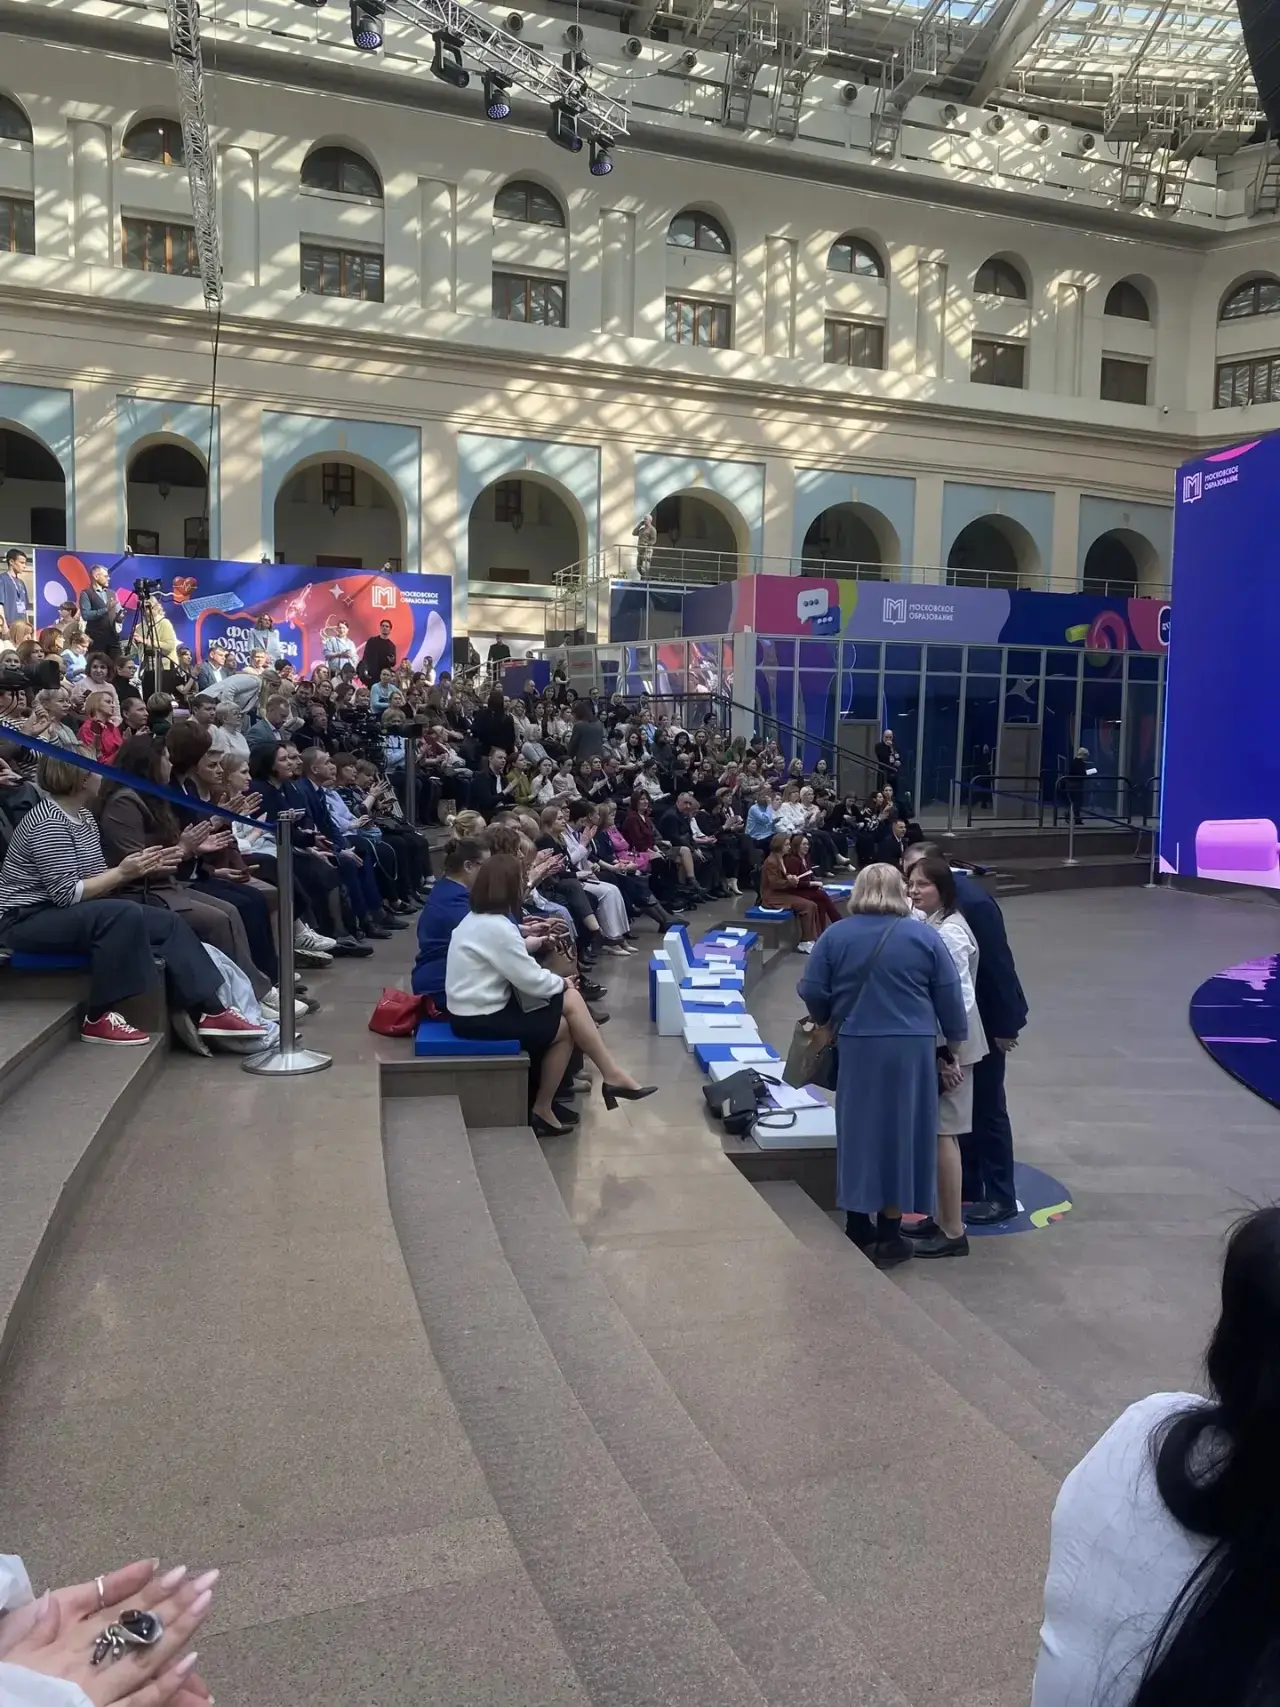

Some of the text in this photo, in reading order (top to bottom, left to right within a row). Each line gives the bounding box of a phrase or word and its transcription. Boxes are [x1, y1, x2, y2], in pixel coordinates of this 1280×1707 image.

[1205, 465, 1239, 482] МОСКОВСКОЕ
[1204, 474, 1239, 490] ОБРАЗОВАНИЕ
[400, 591, 439, 599] МОСКОВСКОЕ
[400, 597, 439, 605] ОБРАЗОВАНИЕ
[909, 603, 954, 613] МОСКОВСКОЕ
[909, 612, 954, 621] ОБРАЗОВАНИЕ
